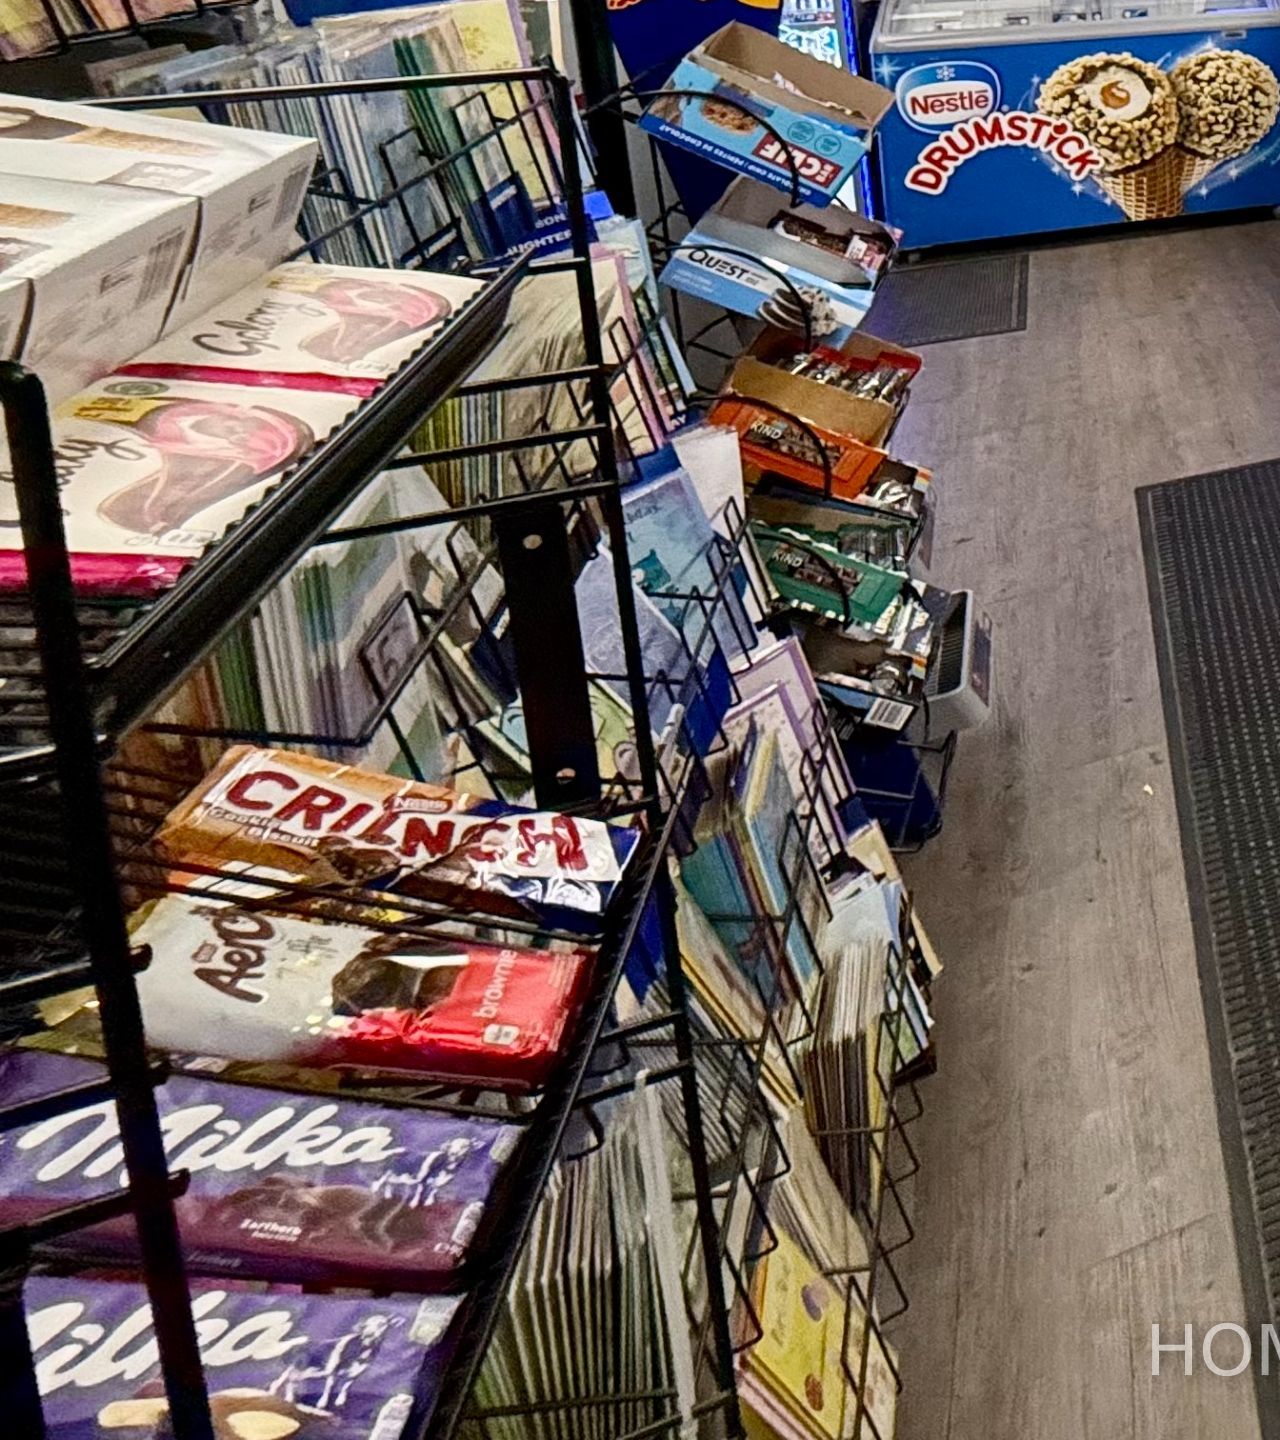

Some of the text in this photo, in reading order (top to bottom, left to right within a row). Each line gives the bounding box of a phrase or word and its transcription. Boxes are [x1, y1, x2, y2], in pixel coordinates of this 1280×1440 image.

[914, 115, 1100, 192] DRUMSTICK
[688, 248, 749, 280] QUEST
[752, 419, 783, 440] KIND
[773, 551, 802, 567] KIND
[18, 1103, 406, 1188] Milka
